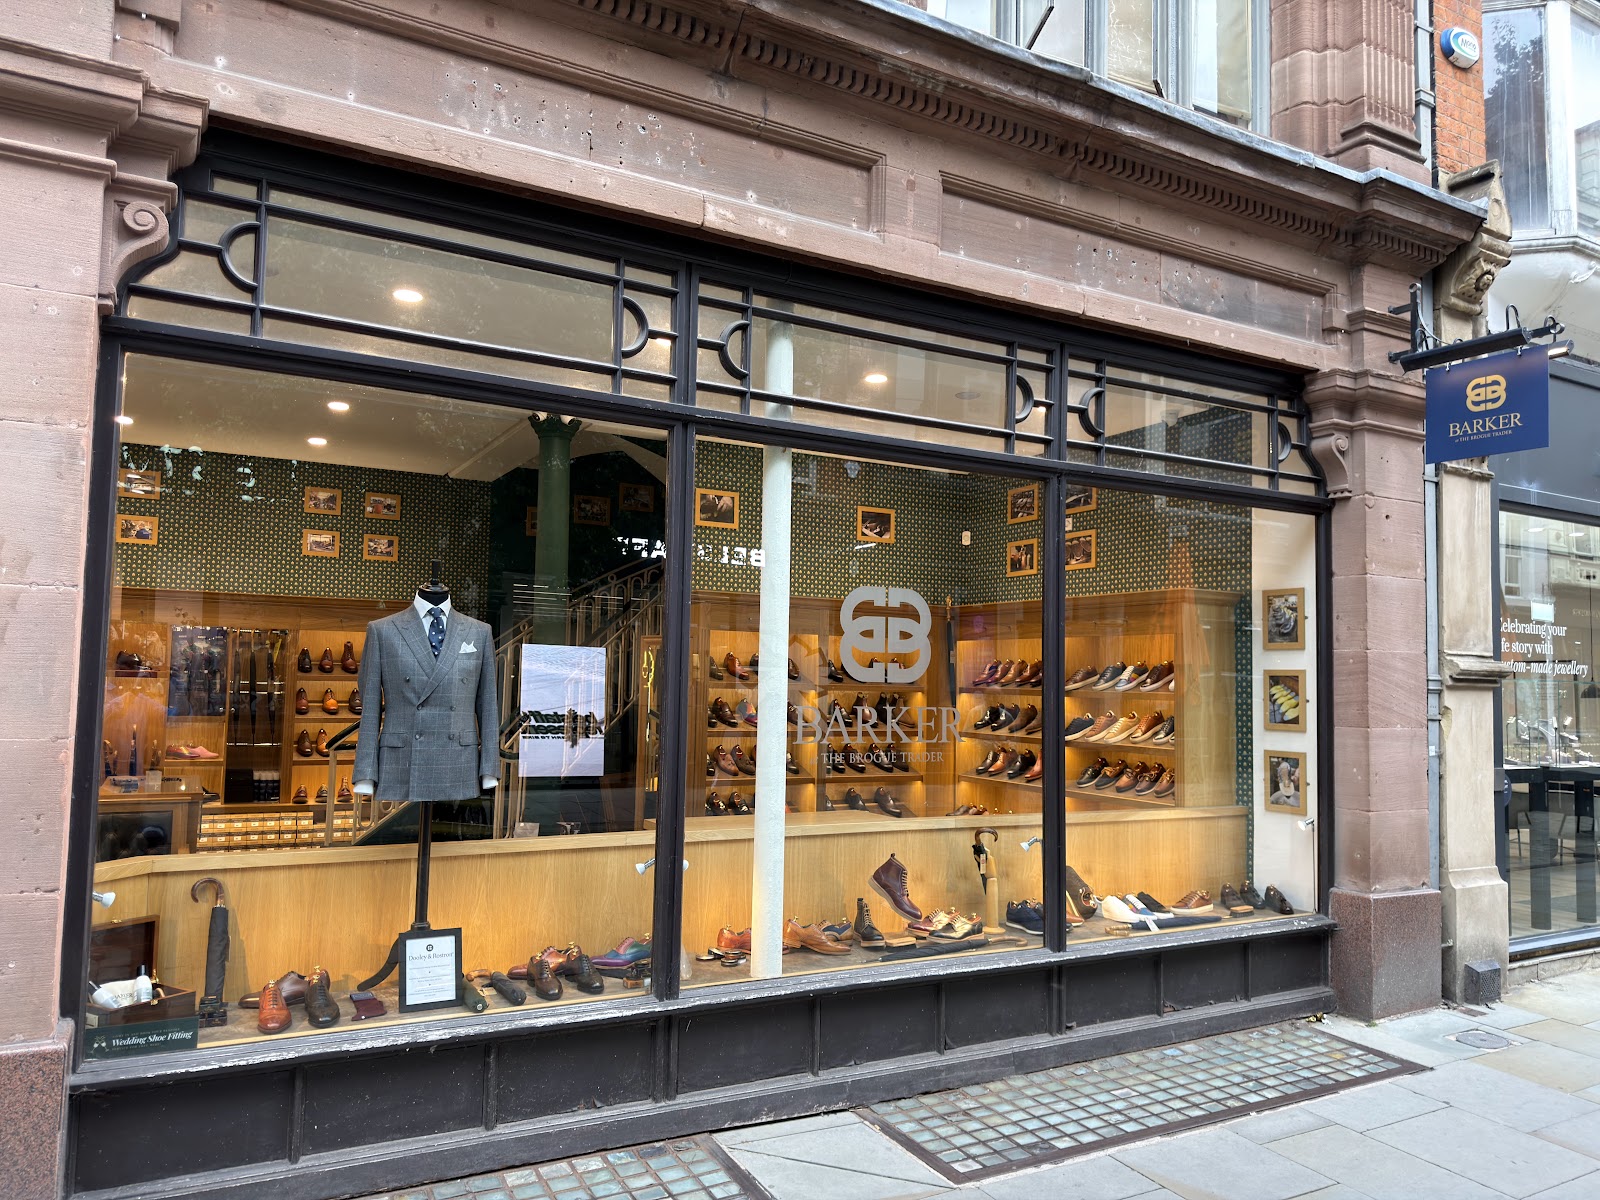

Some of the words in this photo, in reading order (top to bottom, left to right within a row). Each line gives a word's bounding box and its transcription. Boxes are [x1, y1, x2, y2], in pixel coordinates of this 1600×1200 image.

[1449, 413, 1523, 437] BARKER
[1547, 625, 1568, 640] your
[1511, 642, 1534, 658] story
[1534, 640, 1554, 655] with
[1553, 659, 1589, 678] jewellery
[792, 705, 967, 746] BARKER
[820, 753, 846, 764] THE
[849, 752, 897, 764] BROGUE
[900, 751, 944, 764] TRADER
[112, 1035, 147, 1047] Wedding
[147, 1033, 166, 1042] Shoe
[167, 1030, 194, 1041] Fitting
